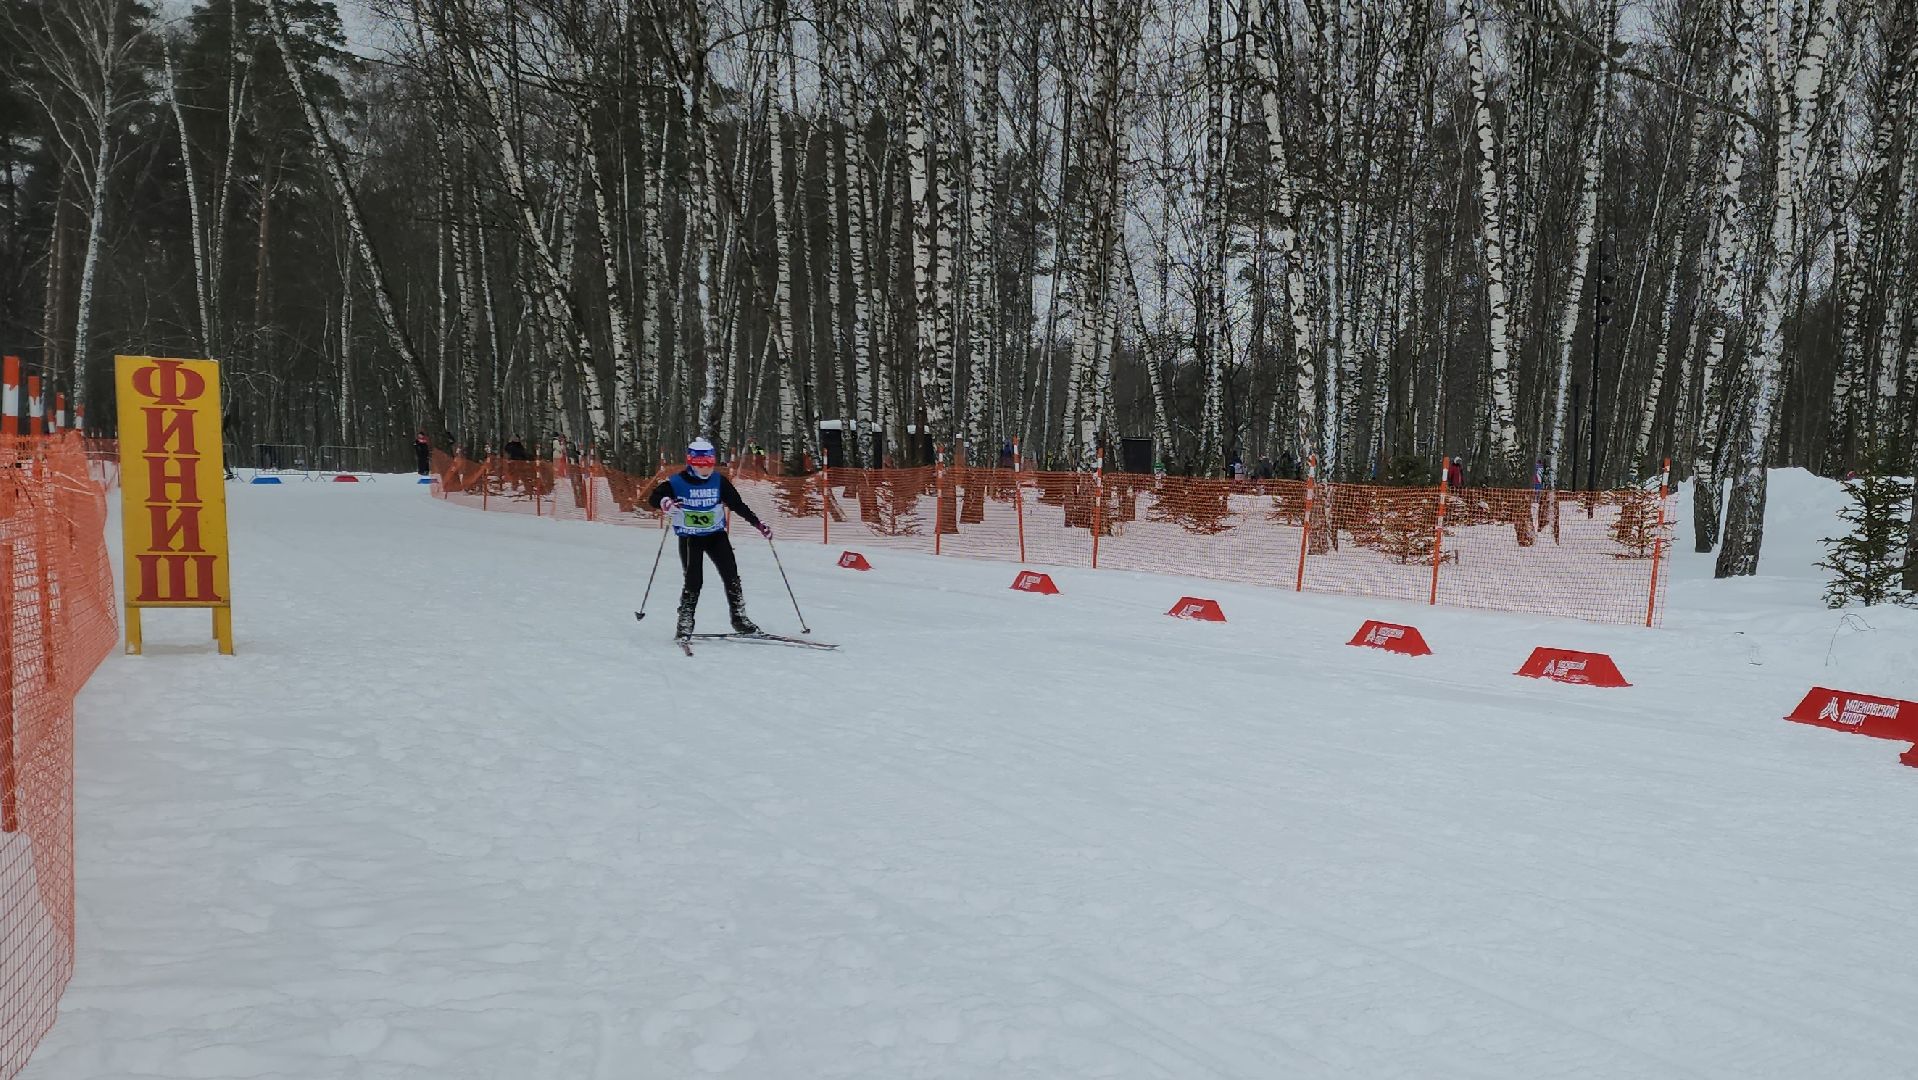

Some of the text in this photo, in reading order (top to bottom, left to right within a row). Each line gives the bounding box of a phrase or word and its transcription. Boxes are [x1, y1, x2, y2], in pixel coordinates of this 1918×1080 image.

[132, 360, 221, 600] ФИНИШ
[1840, 711, 1867, 727] СПОРТ
[1843, 699, 1899, 719] МОСКОВСКИЙ
